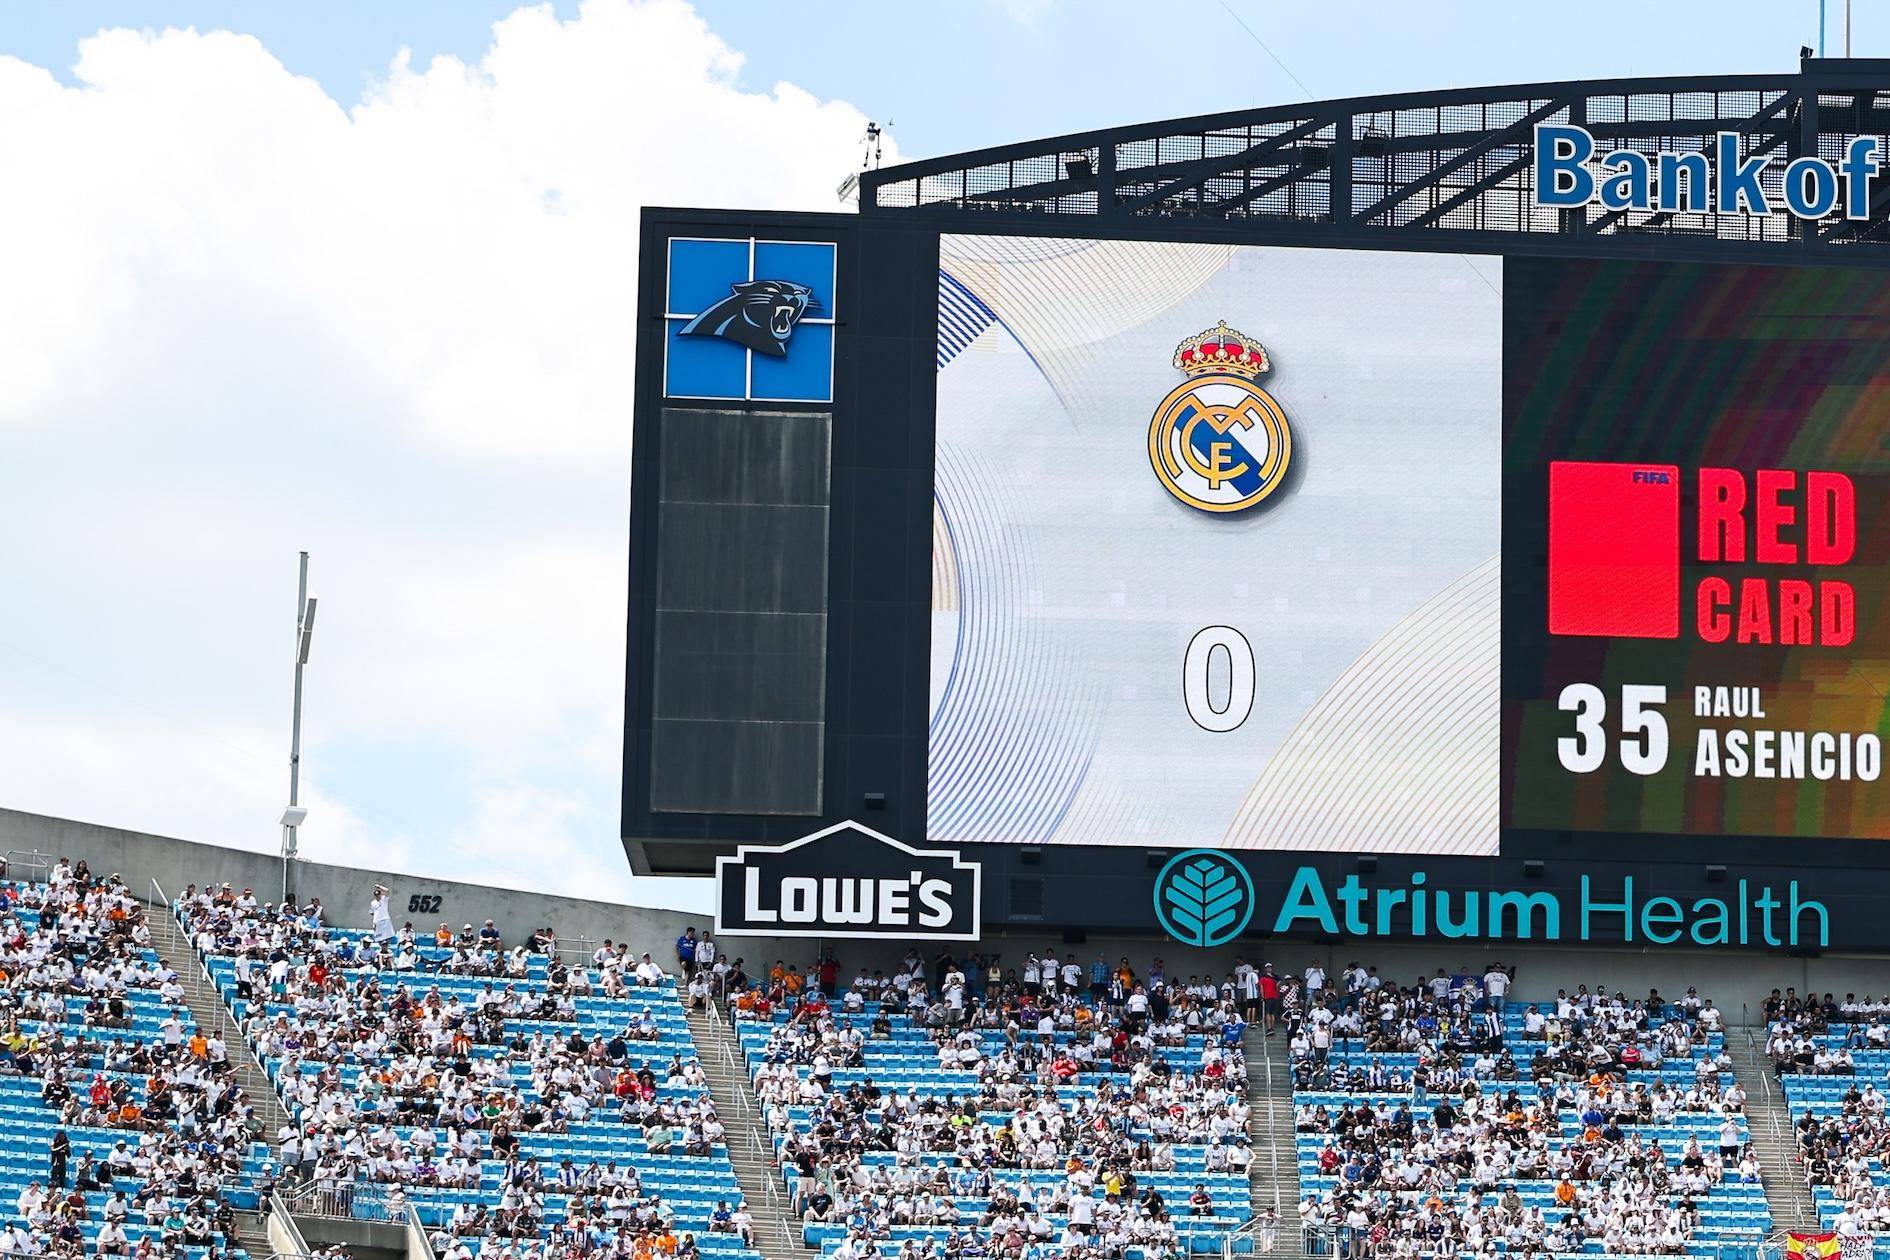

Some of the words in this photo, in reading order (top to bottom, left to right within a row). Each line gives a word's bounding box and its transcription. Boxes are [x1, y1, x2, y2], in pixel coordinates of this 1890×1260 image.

[1532, 123, 1773, 219] Bank
[1781, 134, 1881, 221] of
[1632, 471, 1671, 485] FIFA
[1698, 467, 1857, 566] RED
[1696, 576, 1857, 648] CARD
[1184, 626, 1256, 733] 0
[1694, 685, 1766, 718] RAUL
[1557, 682, 1670, 776] 35
[1694, 728, 1882, 782] ASENCIO
[407, 894, 443, 915] 552
[743, 865, 954, 928] LOWE'S
[1273, 866, 1561, 941] Atrium
[1579, 873, 1830, 947] Health
